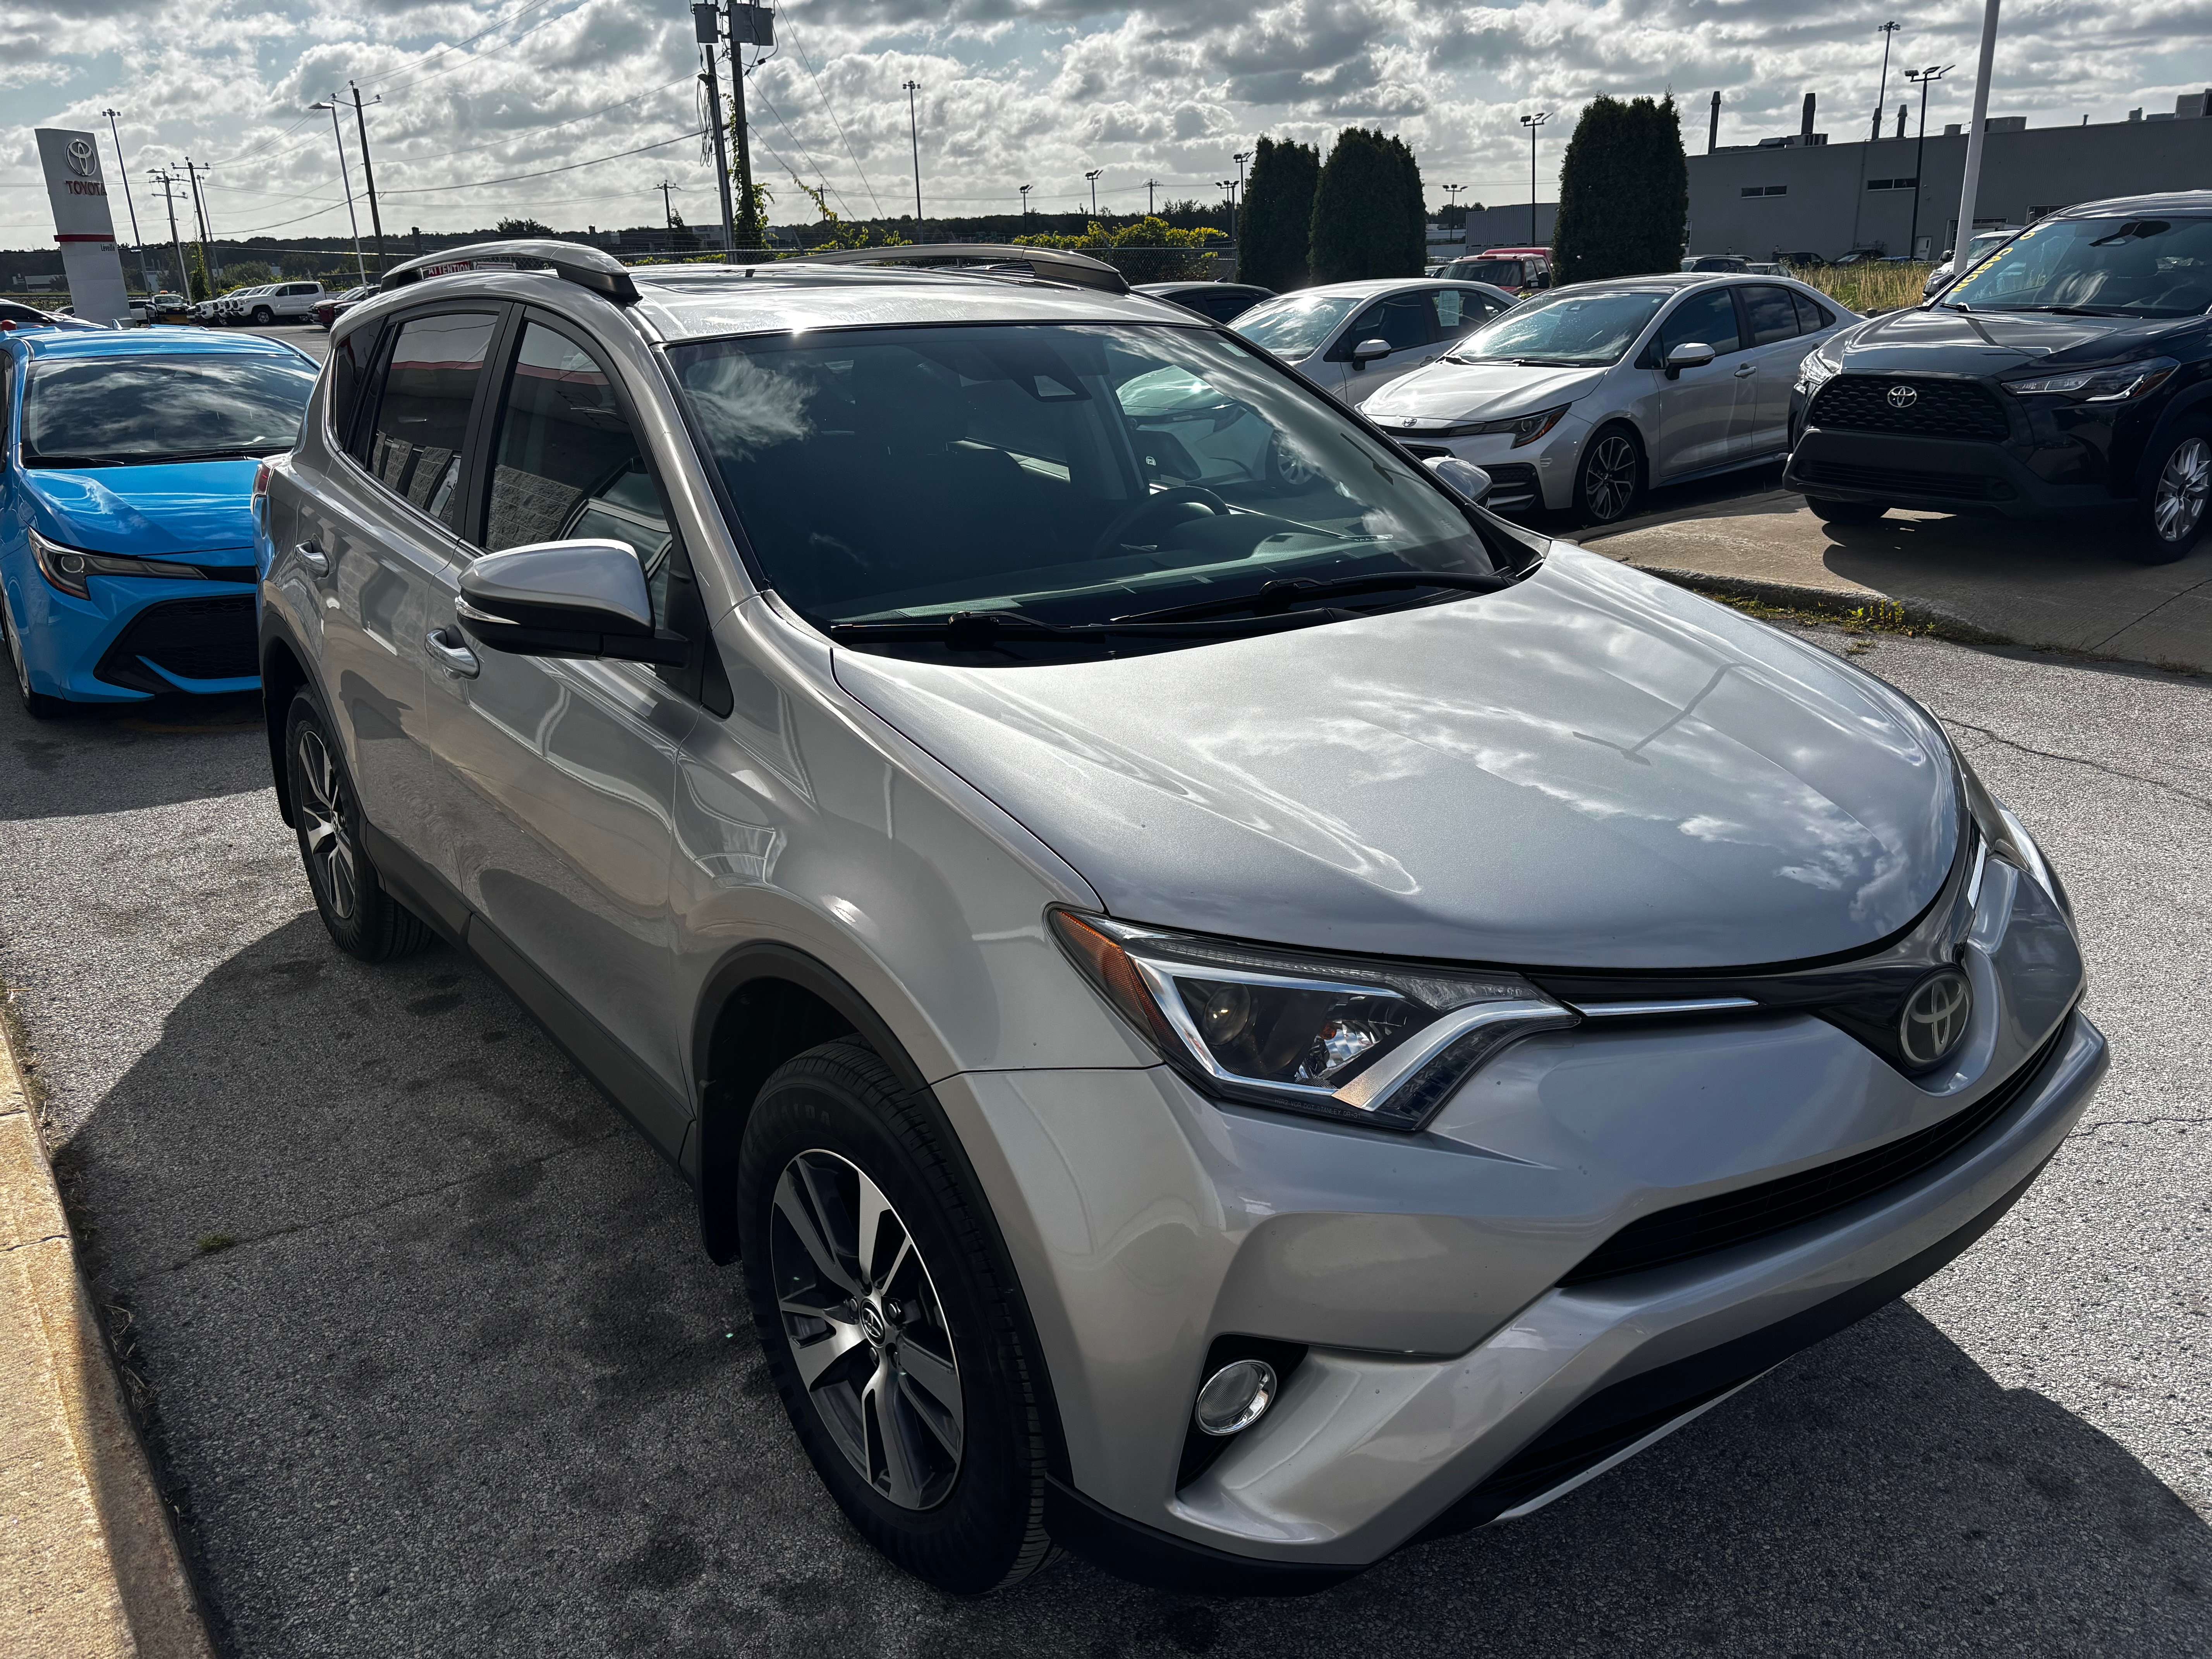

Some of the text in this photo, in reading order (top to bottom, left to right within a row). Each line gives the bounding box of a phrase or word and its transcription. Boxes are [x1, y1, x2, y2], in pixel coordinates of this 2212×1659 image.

[65, 180, 107, 196] TOYOTA
[428, 264, 471, 275] ATTENTION
[1316, 1106, 1341, 1115] STANLEY
